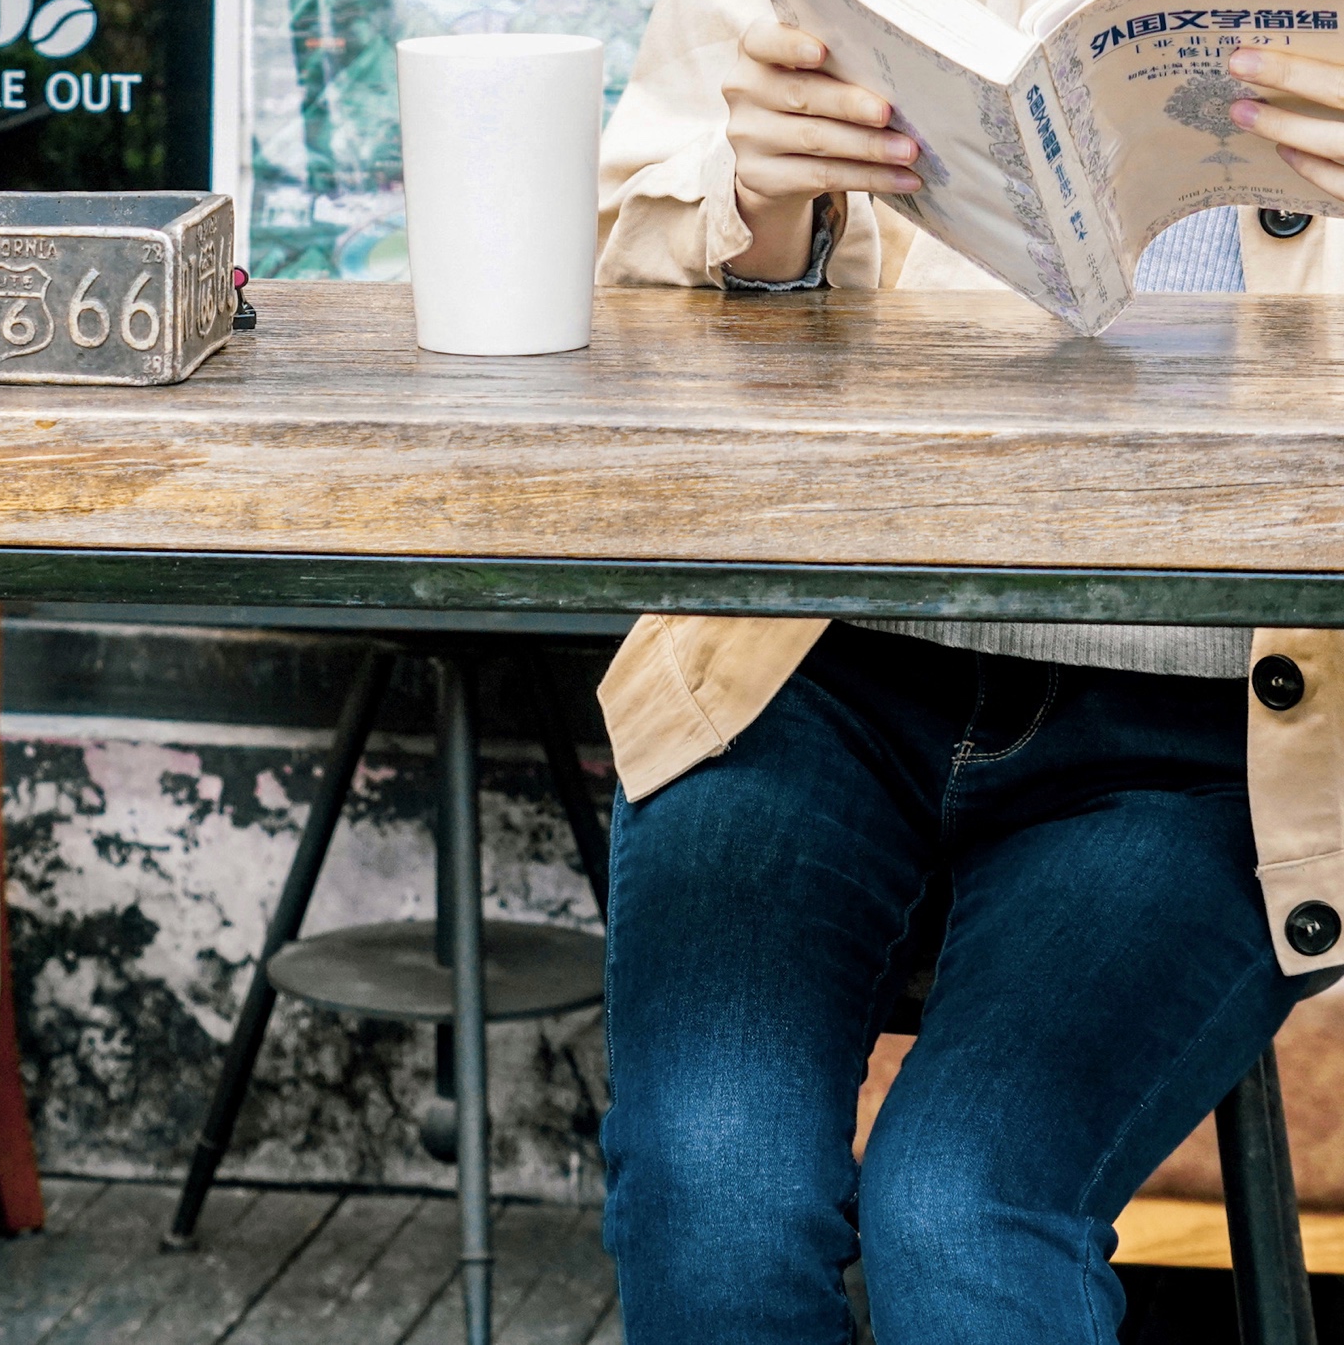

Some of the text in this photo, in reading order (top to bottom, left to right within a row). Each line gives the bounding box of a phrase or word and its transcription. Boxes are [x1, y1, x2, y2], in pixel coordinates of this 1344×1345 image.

[1090, 9, 1338, 59] 外国文学简编
[45, 72, 143, 114] OUT
[69, 268, 160, 351] 66
